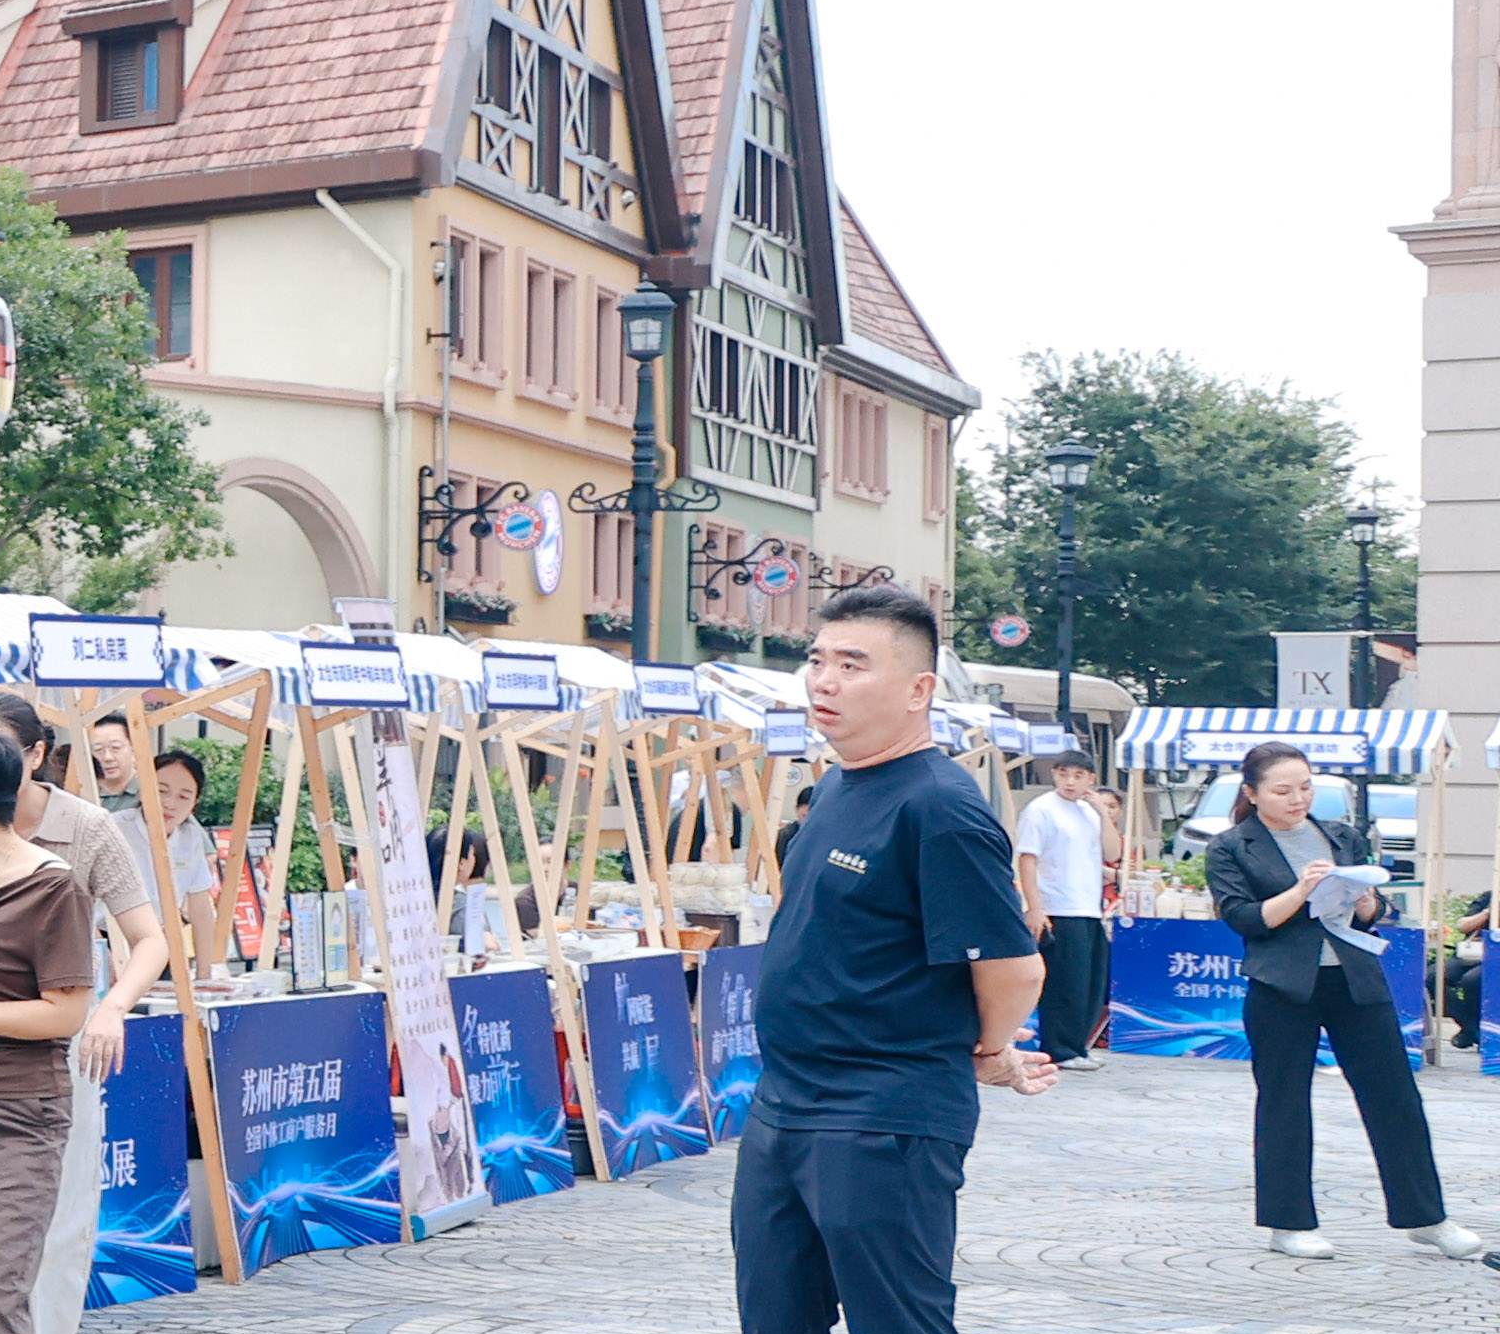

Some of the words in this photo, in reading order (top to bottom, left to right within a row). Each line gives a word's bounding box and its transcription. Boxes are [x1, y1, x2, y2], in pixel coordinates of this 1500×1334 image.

[241, 1059, 342, 1117] 苏州市第五届
